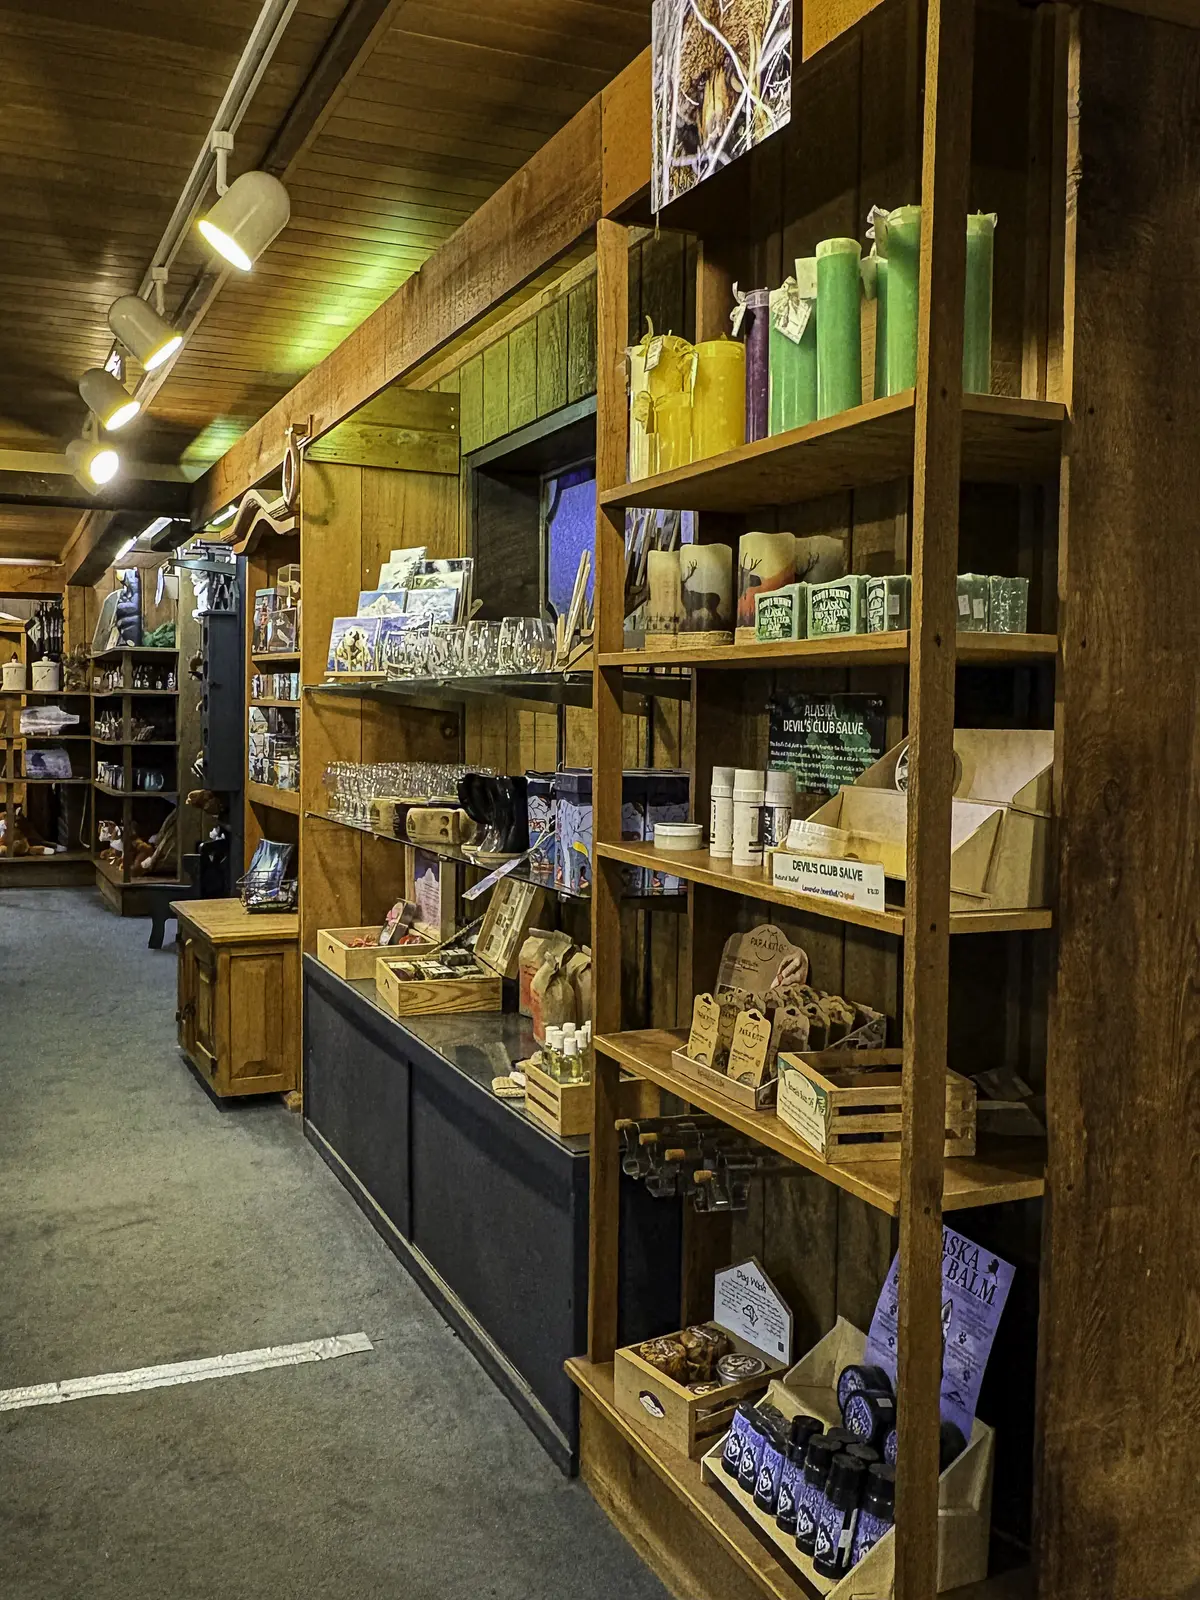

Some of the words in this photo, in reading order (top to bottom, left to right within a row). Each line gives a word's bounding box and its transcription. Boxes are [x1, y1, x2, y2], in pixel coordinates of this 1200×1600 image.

[804, 704, 838, 718] ALASKA
[783, 719, 812, 733] DEVIL'S
[812, 720, 836, 734] CLUB
[835, 722, 864, 735] SALVE
[792, 859, 818, 874] DEVIL'S
[819, 864, 838, 877] CLUB
[838, 867, 863, 881] SALVE
[945, 1258, 998, 1307] BALM
